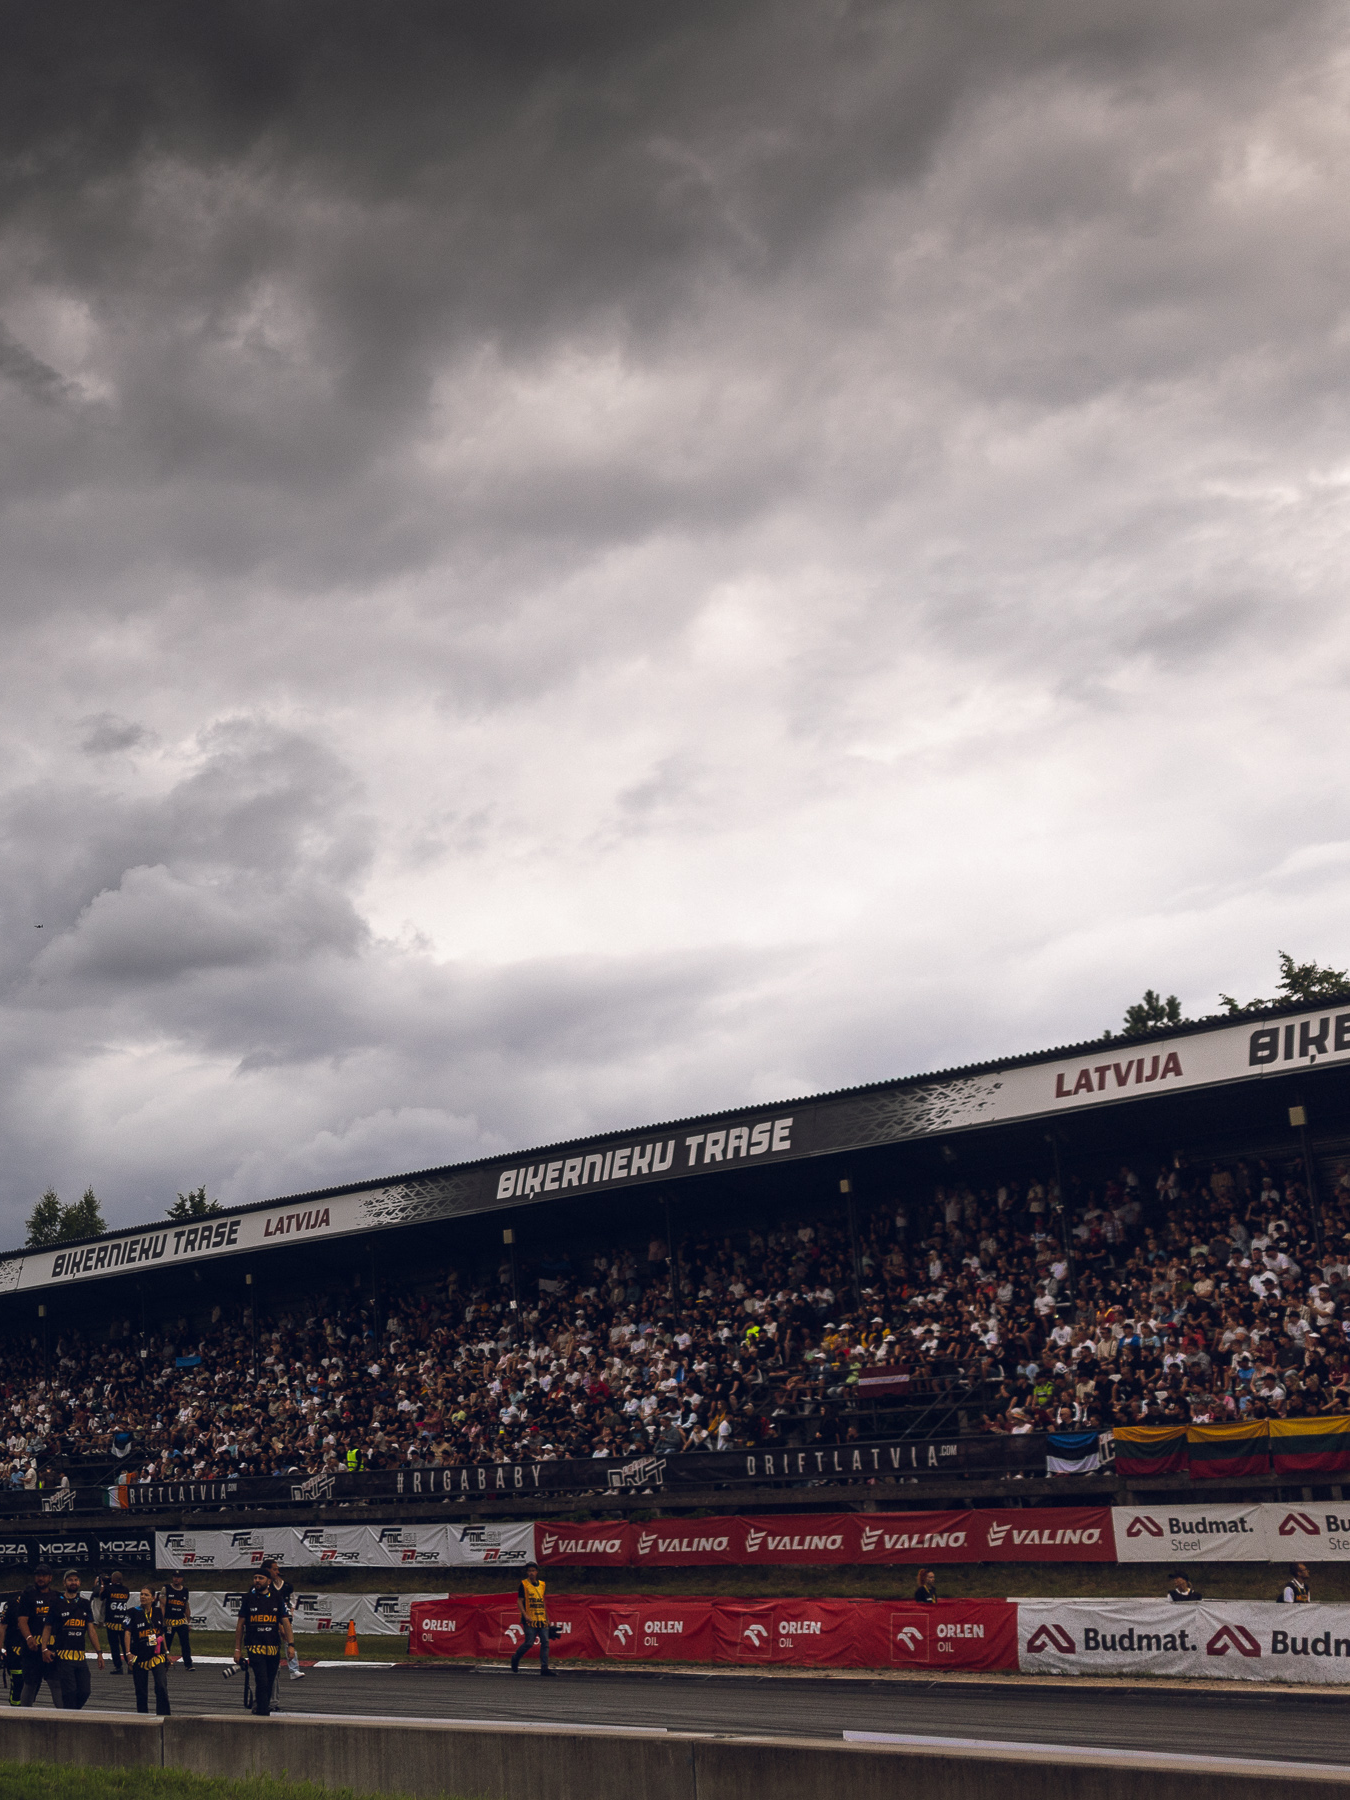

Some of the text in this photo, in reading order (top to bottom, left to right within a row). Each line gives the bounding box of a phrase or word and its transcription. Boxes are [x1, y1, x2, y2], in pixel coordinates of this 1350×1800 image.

[1055, 1052, 1183, 1099] LATVIJA
[496, 1117, 794, 1200] BIĶERNIEKU TRASE
[264, 1208, 331, 1238] LATVIJA
[51, 1219, 241, 1279] BIĶERNIEKU TRASE
[397, 1465, 541, 1493] #RIGABABY
[1168, 1516, 1253, 1535] Budmat.
[767, 1534, 844, 1550] VALINO
[884, 1531, 967, 1548] VALINO
[1012, 1529, 1102, 1544] VALINO
[39, 1542, 89, 1552] MOZA
[100, 1541, 150, 1551] MOZA
[558, 1539, 622, 1553] VALINO
[657, 1536, 730, 1552] VALINO
[1171, 1539, 1202, 1551] Steel
[422, 1619, 455, 1632] ORLEN
[644, 1621, 683, 1634] ORLEN
[779, 1621, 821, 1634] ORLEN
[937, 1624, 984, 1638] ORLEN
[422, 1633, 434, 1642] OIL
[644, 1636, 659, 1646] OIL
[779, 1638, 793, 1648] OIL
[1084, 1627, 1197, 1651] Budmat.
[937, 1642, 954, 1652] OIL
